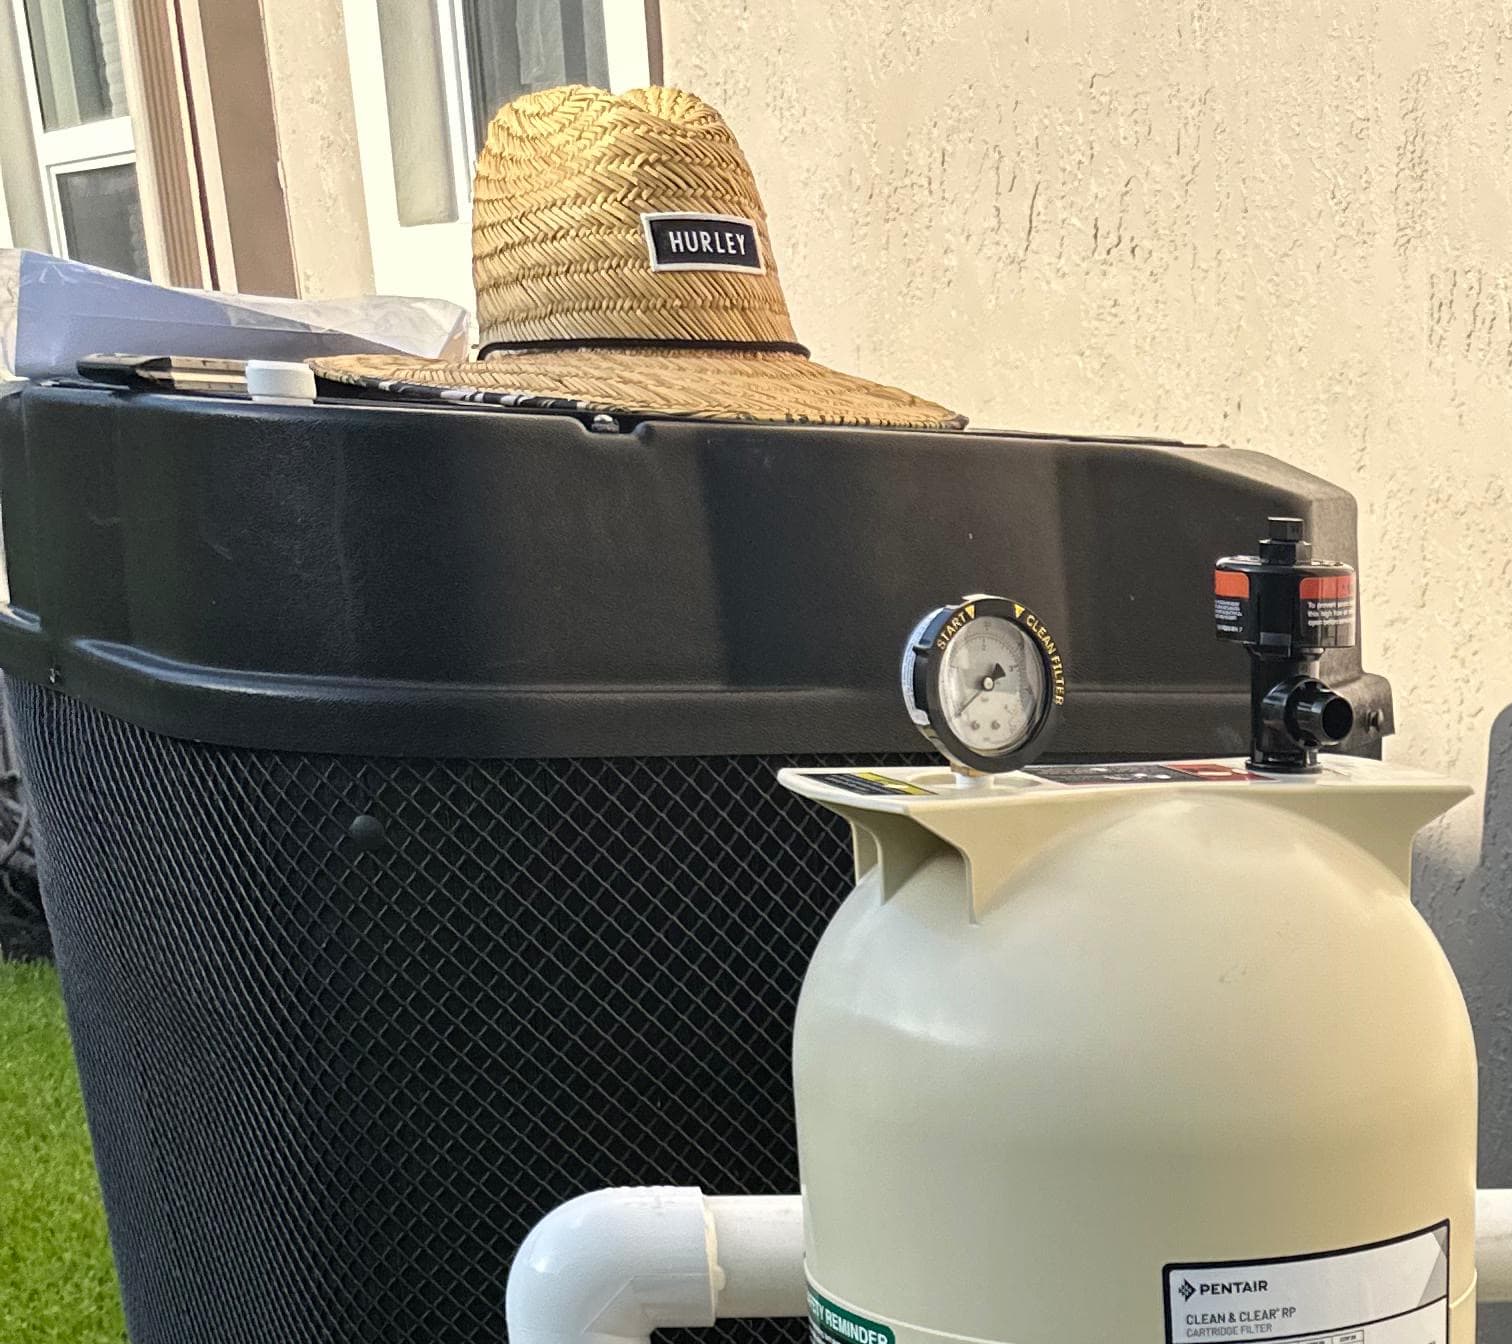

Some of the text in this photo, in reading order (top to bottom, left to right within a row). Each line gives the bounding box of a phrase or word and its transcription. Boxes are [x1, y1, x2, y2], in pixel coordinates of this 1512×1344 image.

[668, 231, 746, 255] HURLEY
[936, 612, 967, 650] START
[1026, 614, 1066, 706] CLEAN FILTER
[1200, 1280, 1268, 1295] PENTAIR
[1186, 1313, 1226, 1325] CLEAN
[1229, 1311, 1236, 1323] &
[1281, 1306, 1297, 1319] RP
[1186, 1323, 1273, 1338] CARTRIDGE FILTER
